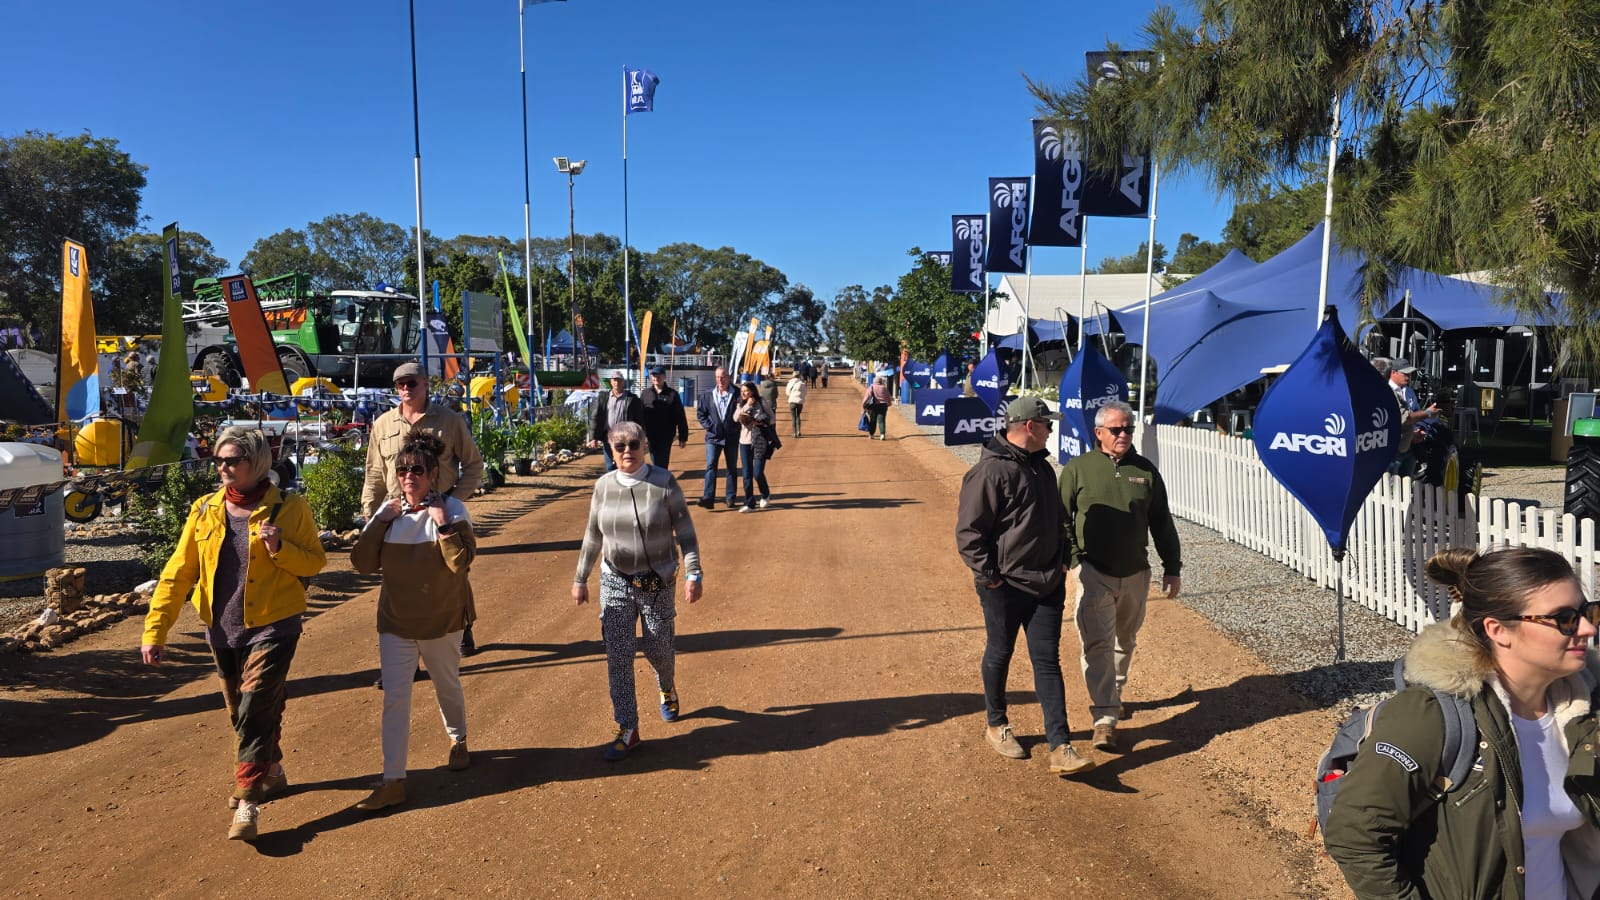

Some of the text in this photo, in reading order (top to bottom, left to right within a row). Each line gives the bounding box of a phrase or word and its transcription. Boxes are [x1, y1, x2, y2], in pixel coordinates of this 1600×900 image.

[1009, 182, 1027, 268] AFGRI
[969, 219, 983, 288] AFGRI
[1269, 432, 1347, 457] AFGRI
[1377, 744, 1415, 770] CALIFORNIA
